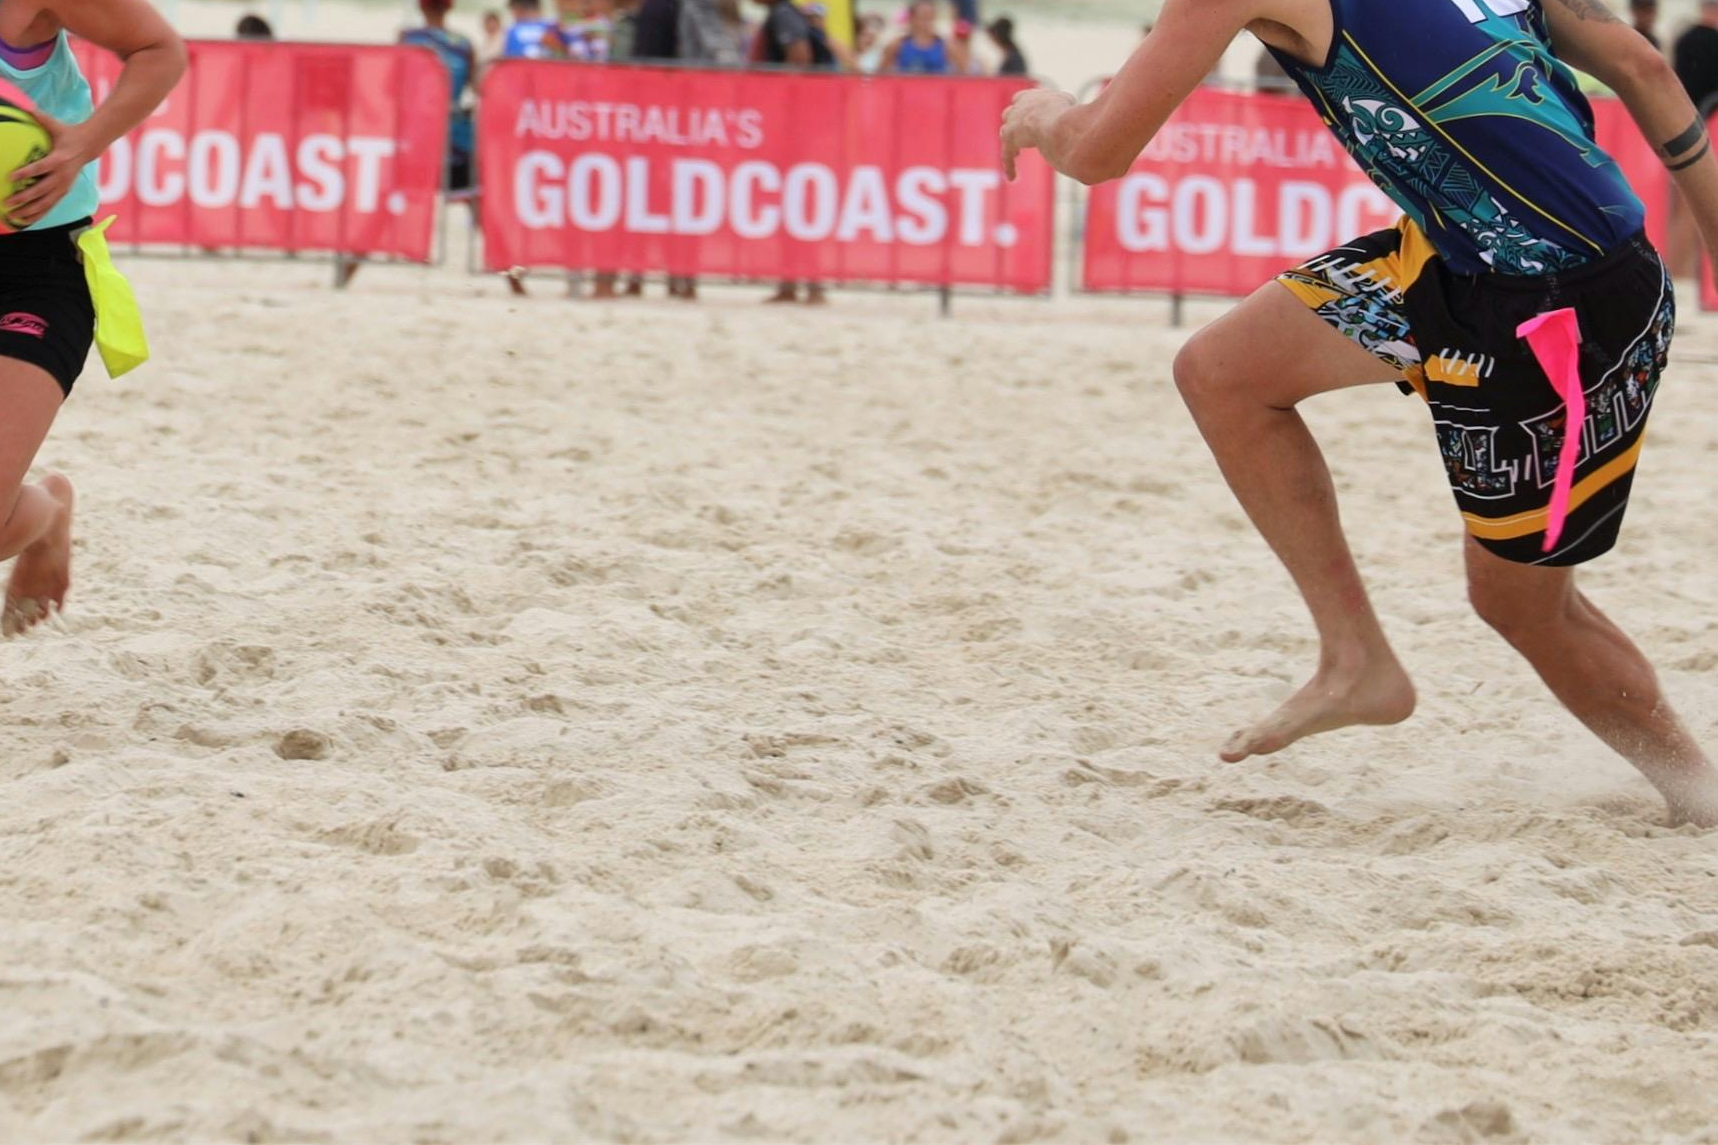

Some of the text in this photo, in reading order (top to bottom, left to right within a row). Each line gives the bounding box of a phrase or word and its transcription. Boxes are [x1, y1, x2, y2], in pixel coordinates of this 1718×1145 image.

[515, 100, 764, 149] AUSTRALIA'S
[514, 150, 1018, 247] GOLDCOAST.
[1116, 170, 1400, 257] GOLDC
